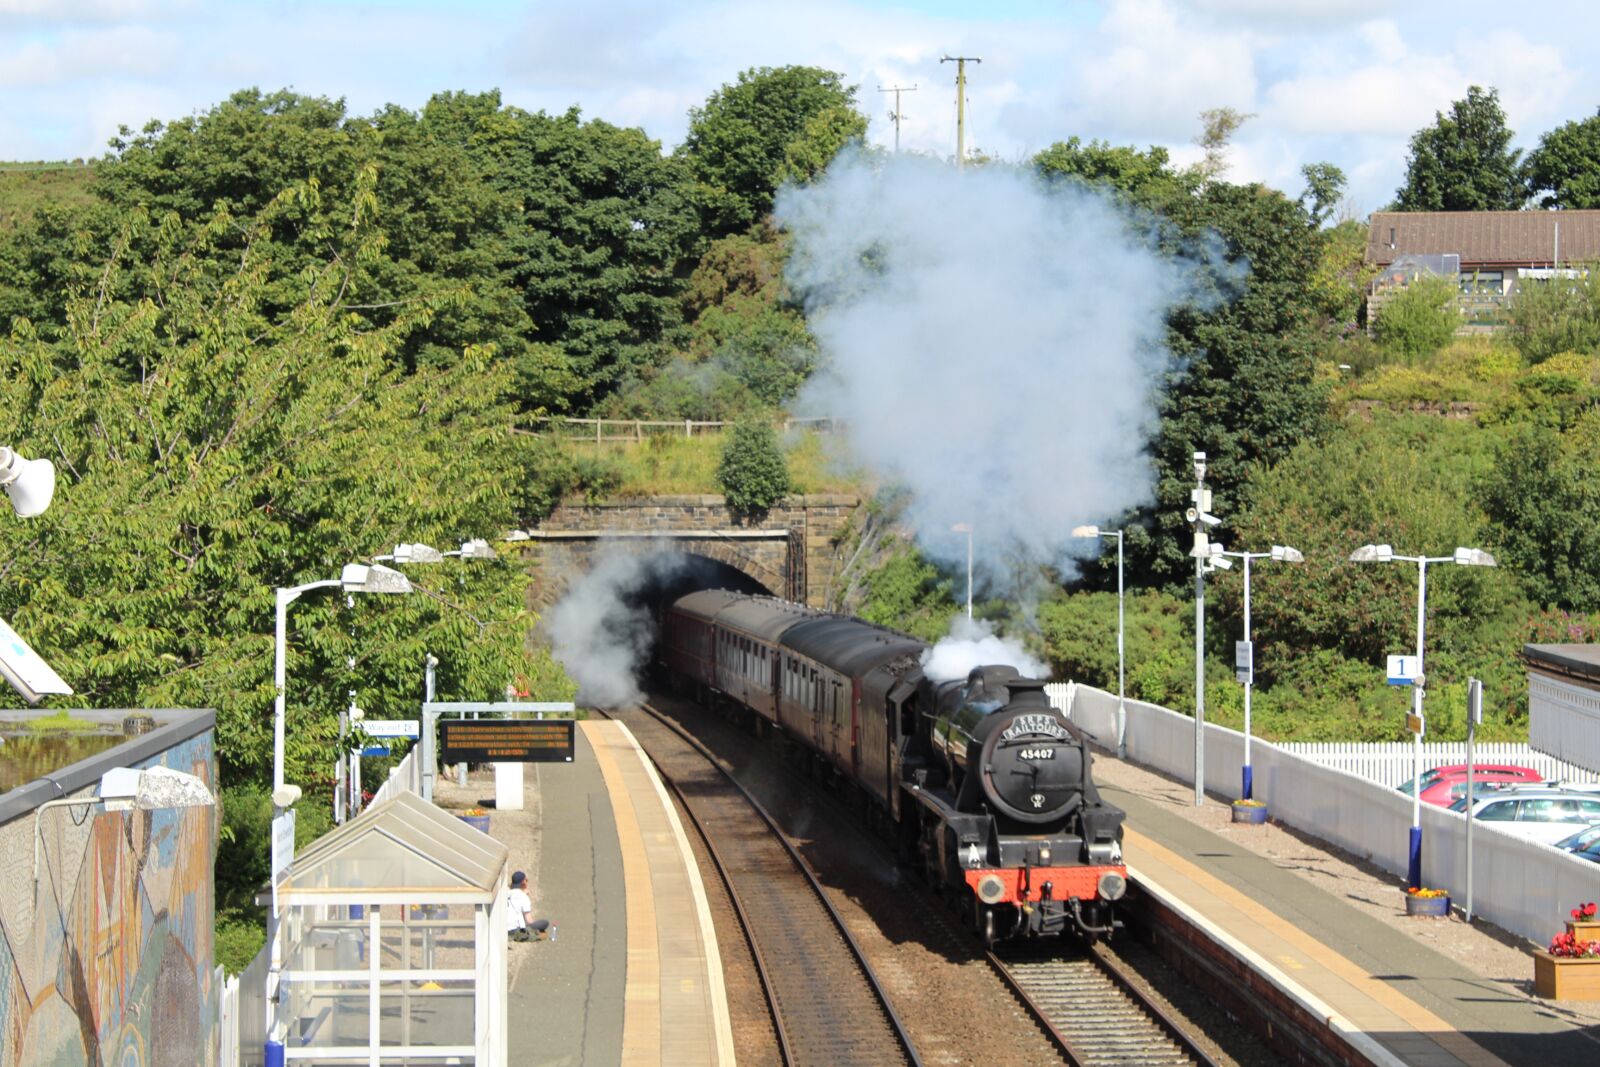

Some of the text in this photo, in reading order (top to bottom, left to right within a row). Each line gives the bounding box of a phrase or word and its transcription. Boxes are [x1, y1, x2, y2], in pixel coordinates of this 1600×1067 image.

[1396, 658, 1406, 676] 1
[1019, 715, 1050, 725] SRPS
[368, 723, 401, 732] Way out
[1008, 723, 1063, 738] RAILTOURS
[1020, 749, 1053, 759] 45407
